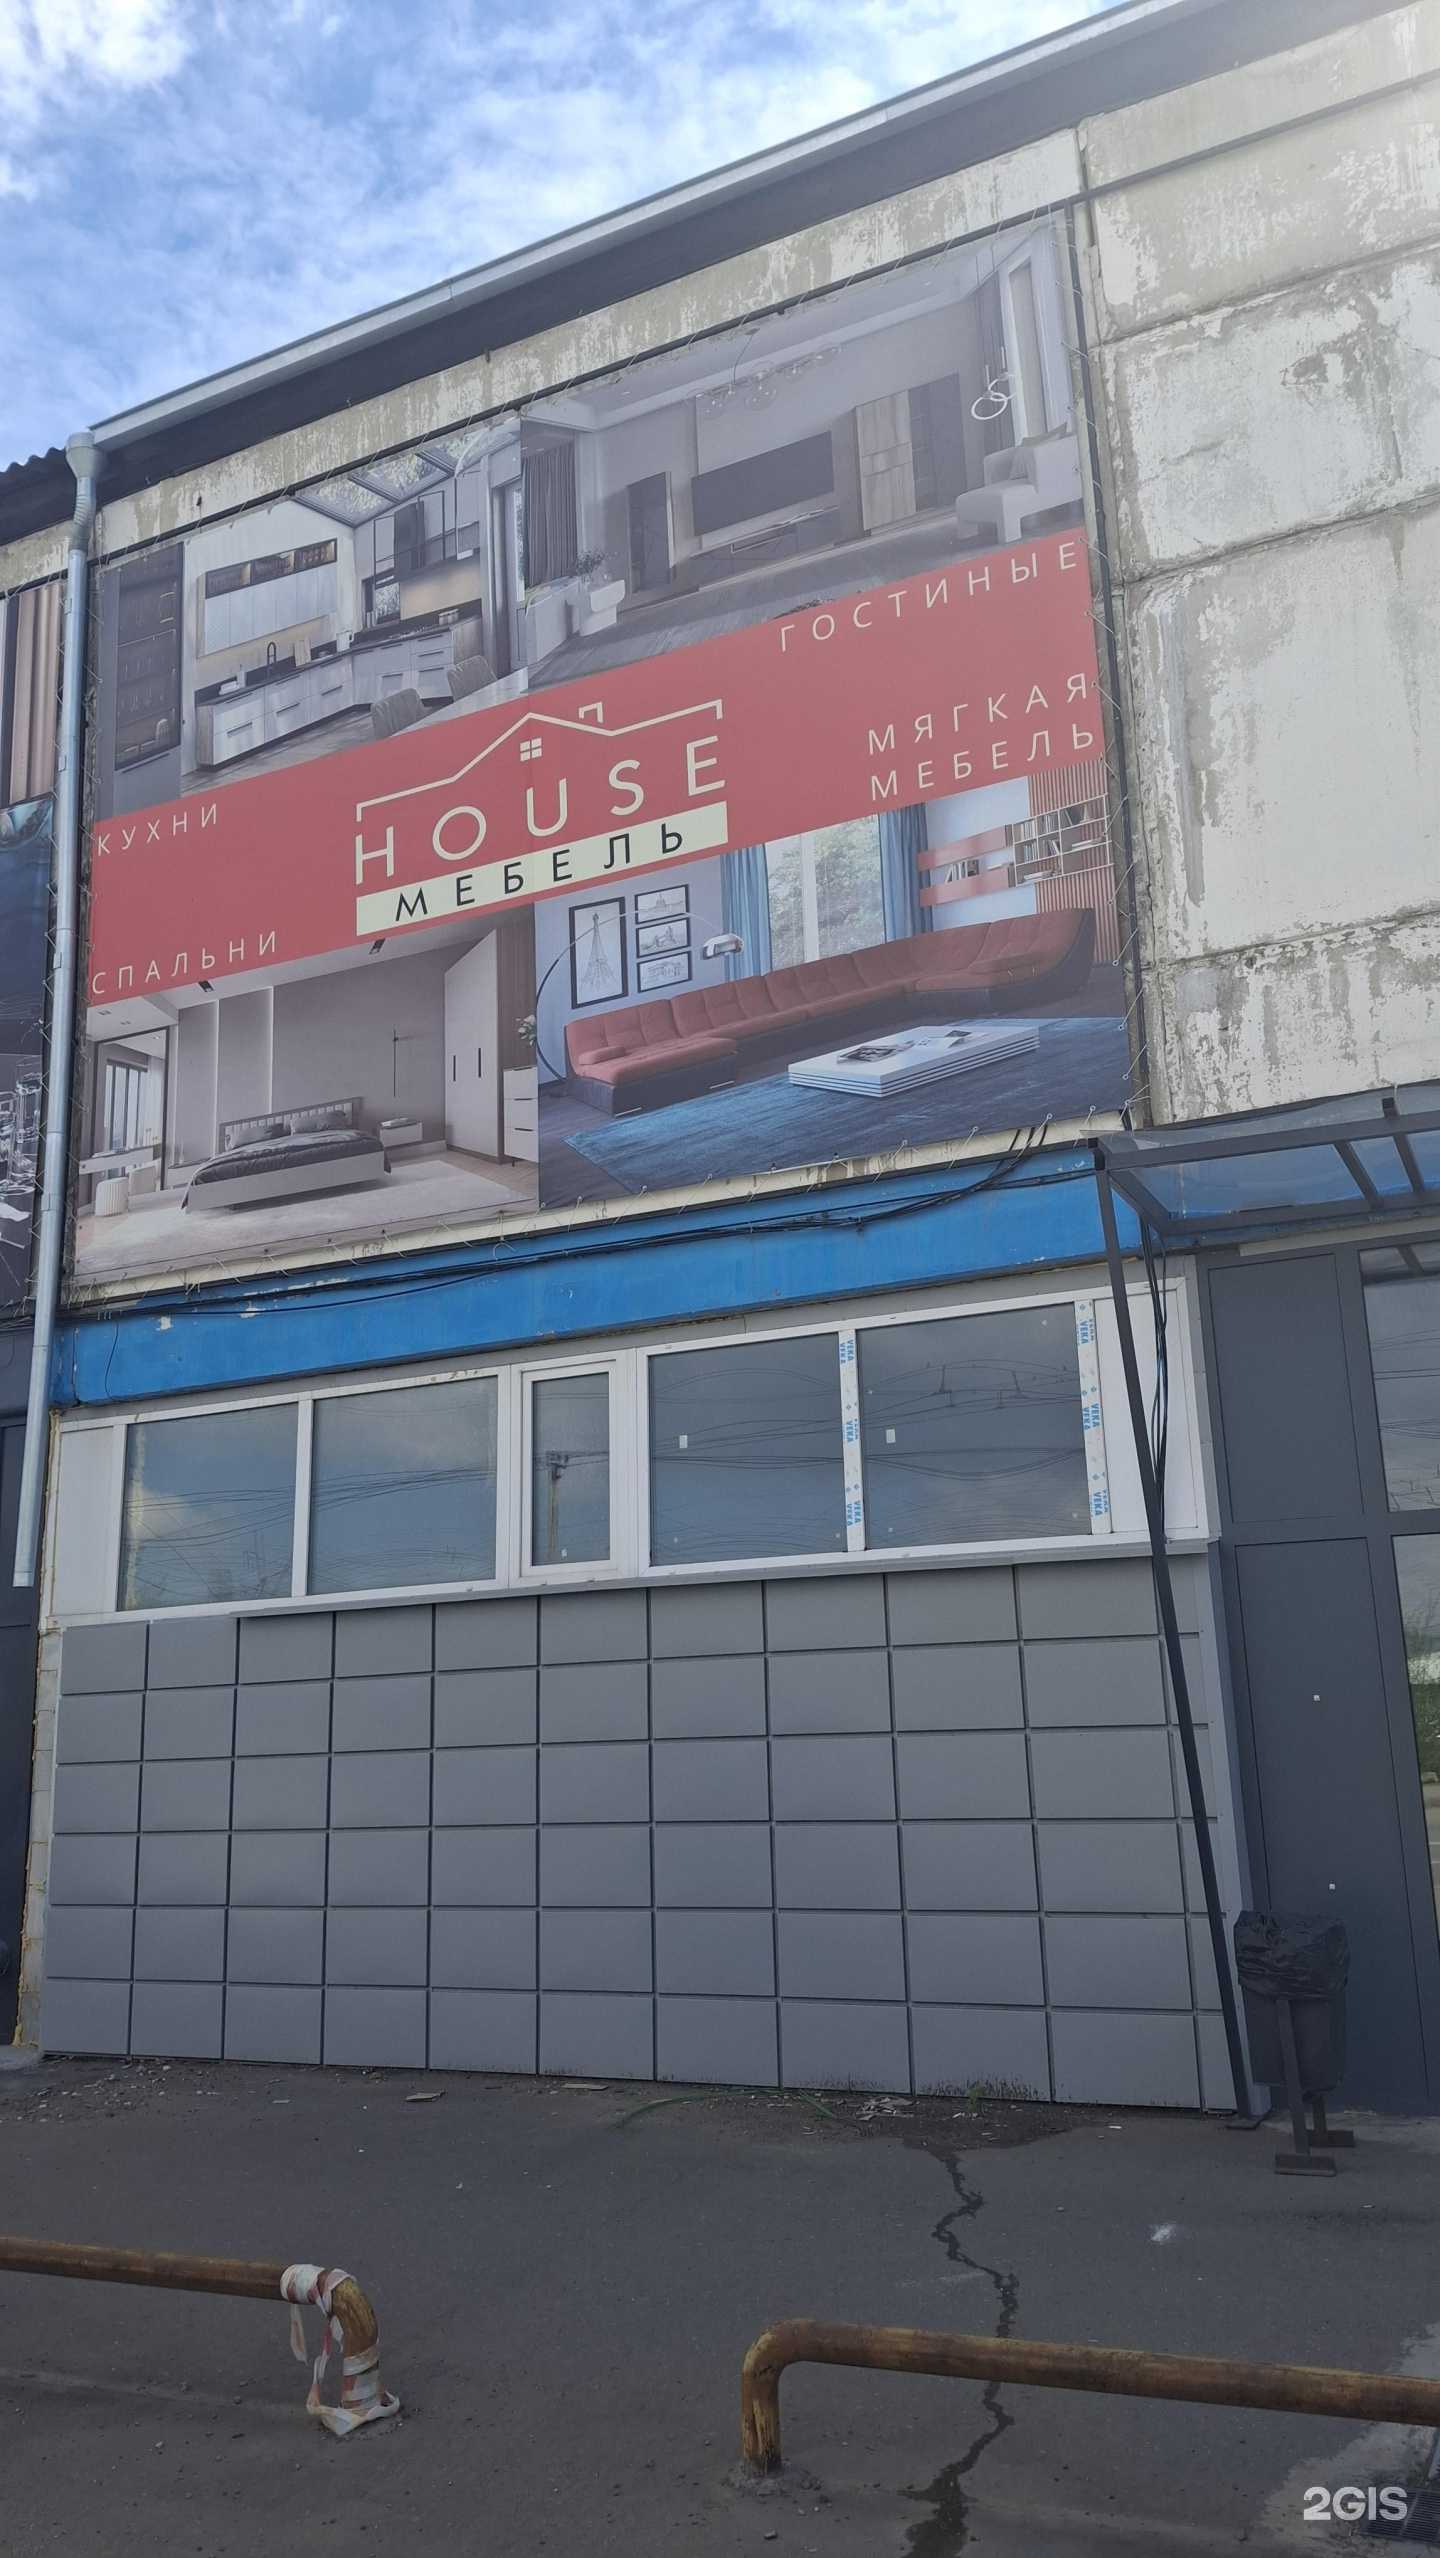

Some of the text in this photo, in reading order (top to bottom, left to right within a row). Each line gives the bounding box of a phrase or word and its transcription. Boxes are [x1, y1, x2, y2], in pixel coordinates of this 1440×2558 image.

[780, 541, 1077, 653] ГОСТИНЫЕ
[868, 673, 1087, 756] МЯГКАЯ
[870, 723, 1094, 801] МЕБЕЛЬ
[97, 803, 217, 857] КУХНИ
[355, 735, 727, 886] HOUSE
[395, 823, 684, 922] МЕБЕЛЬ
[92, 930, 276, 995] СПАЛЬНИ
[1080, 1319, 1089, 1345] VEKA
[1090, 1402, 1100, 1428] VEKA
[1093, 1491, 1103, 1516] VEKA
